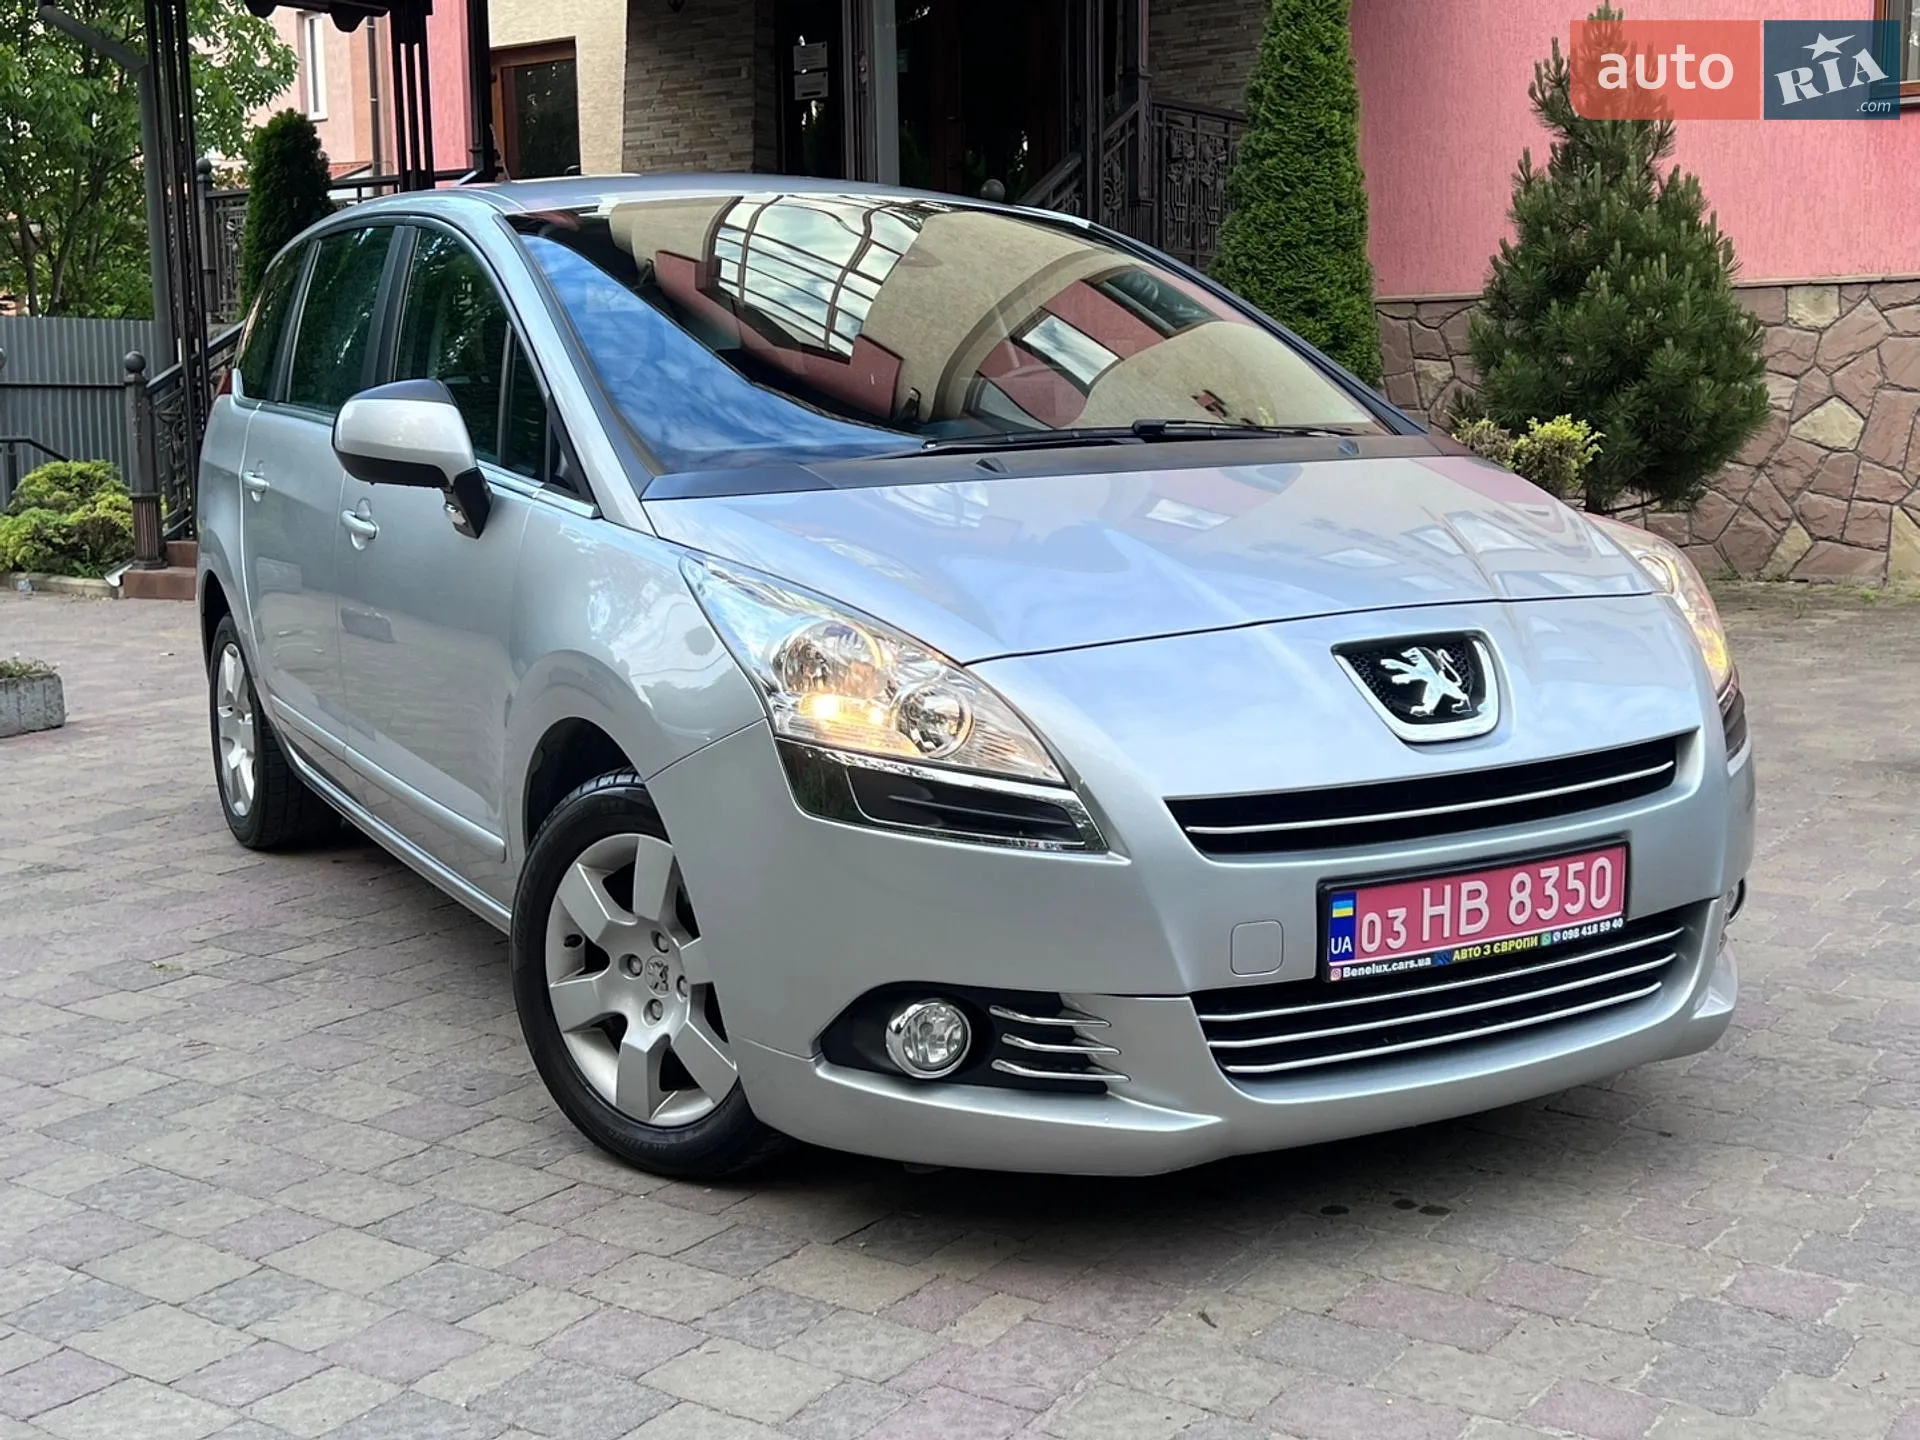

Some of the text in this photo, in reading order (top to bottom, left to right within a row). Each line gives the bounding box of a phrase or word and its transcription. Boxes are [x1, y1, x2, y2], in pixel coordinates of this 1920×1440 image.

[1362, 856, 1612, 953] 03 HB 8350
[1331, 936, 1352, 955] UA
[1453, 945, 1481, 961] АВТО
[1342, 957, 1432, 977] Benelux.cars.ua
